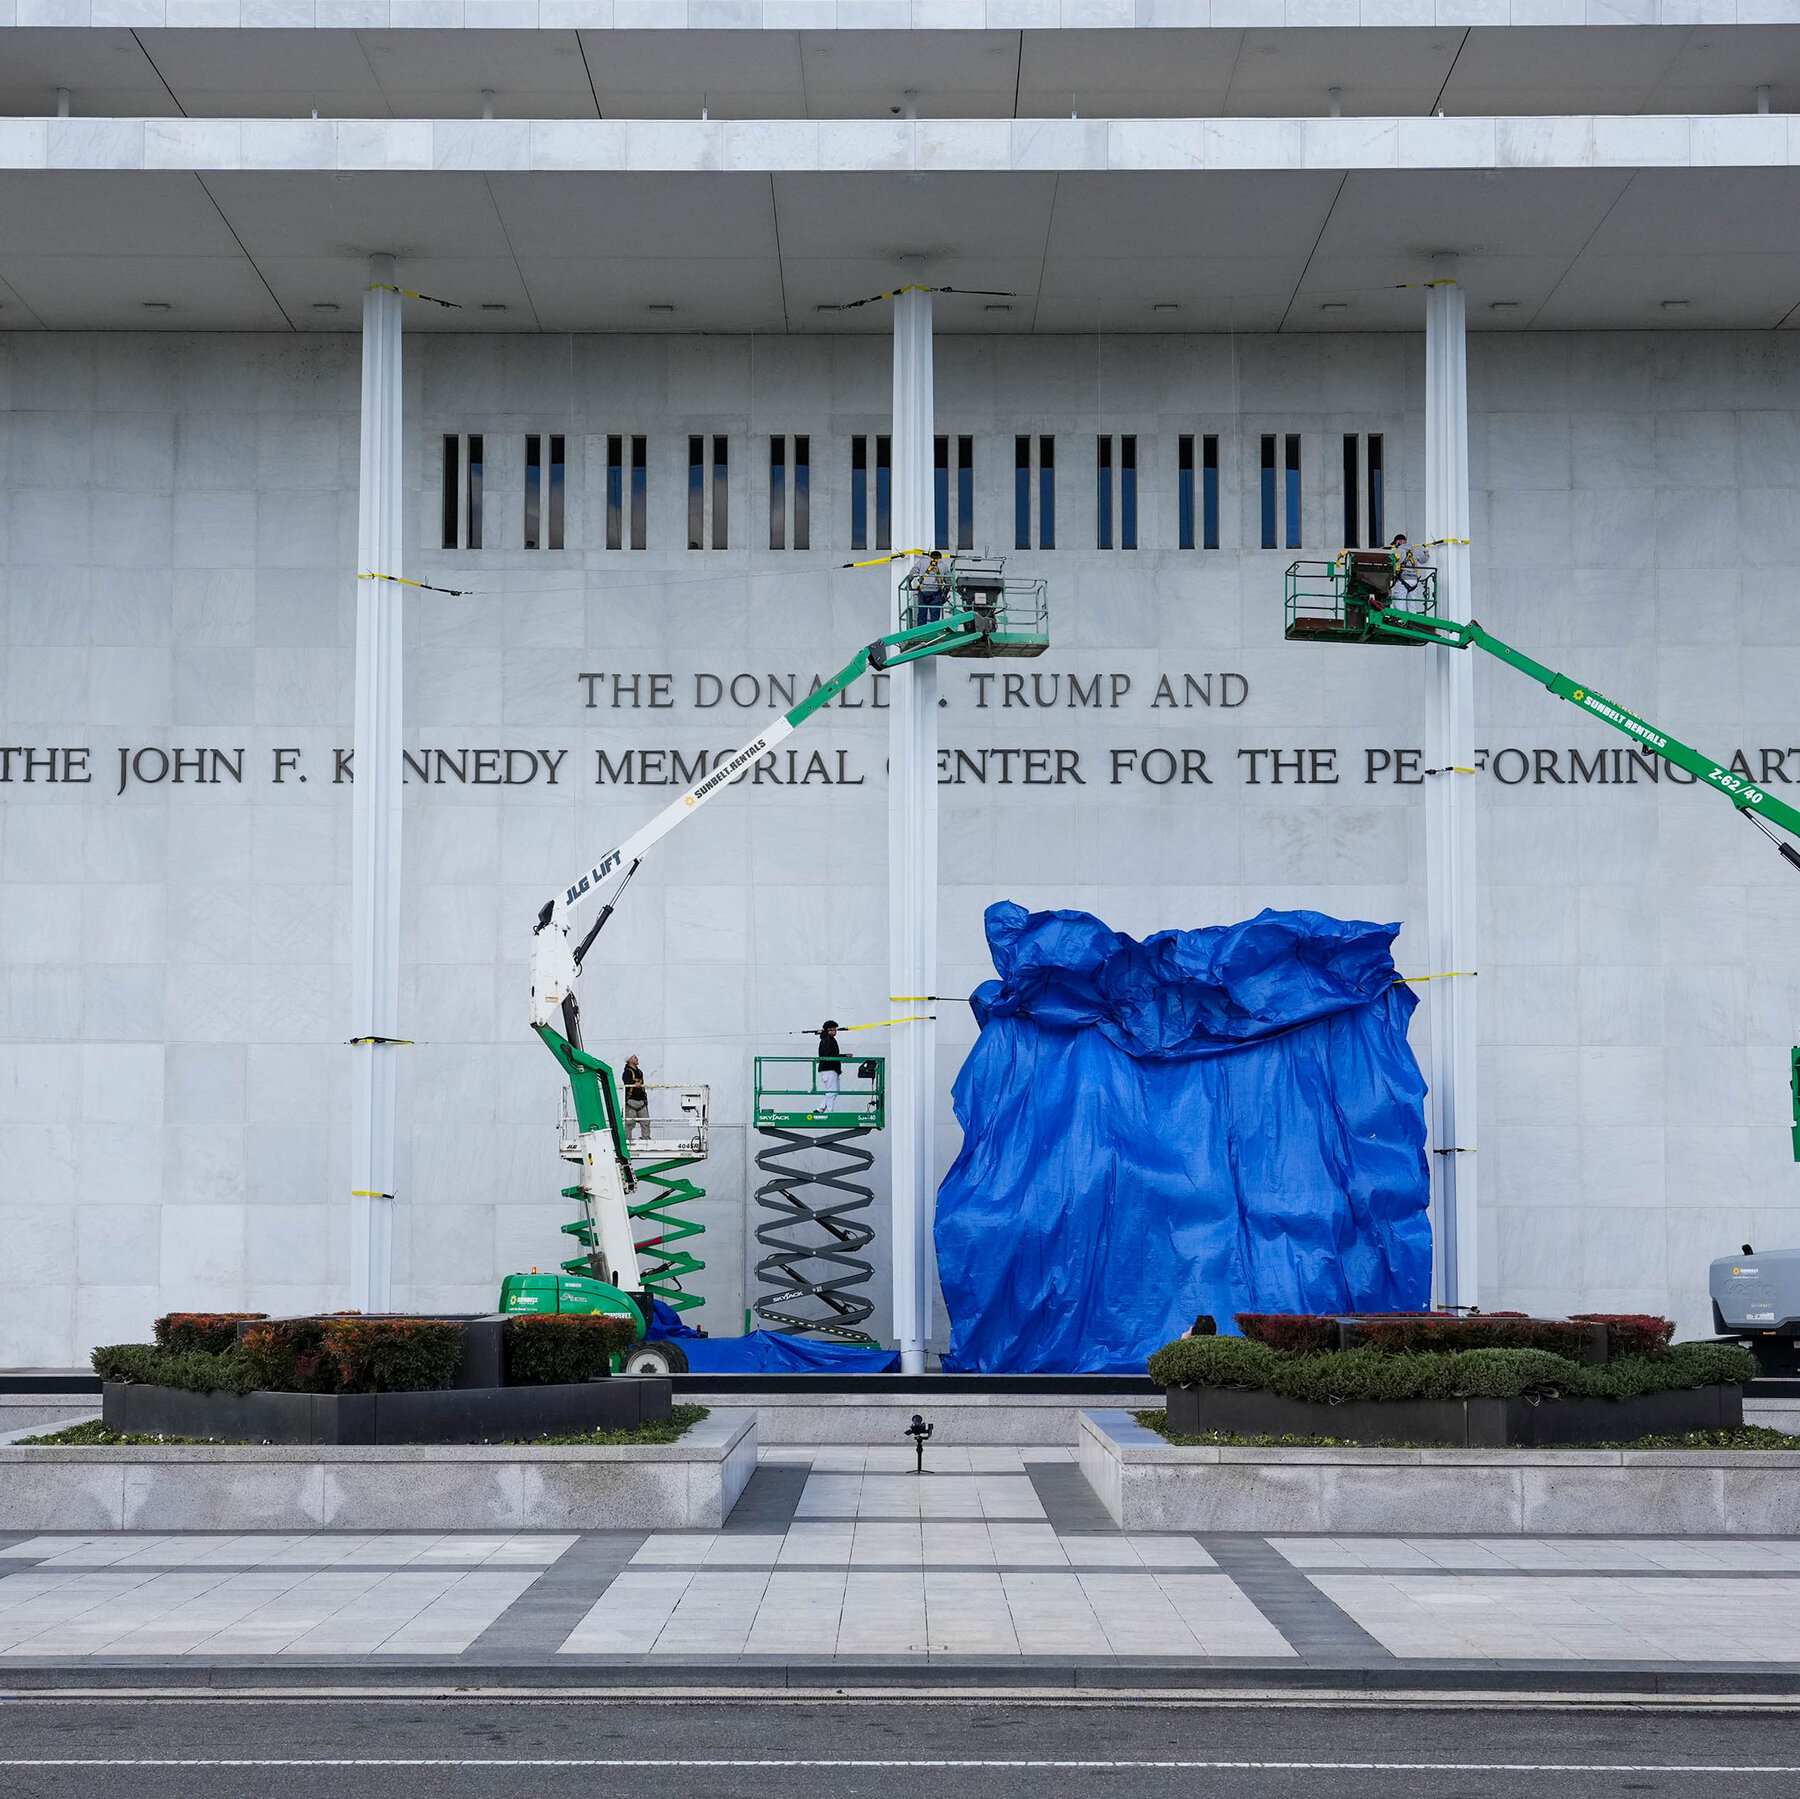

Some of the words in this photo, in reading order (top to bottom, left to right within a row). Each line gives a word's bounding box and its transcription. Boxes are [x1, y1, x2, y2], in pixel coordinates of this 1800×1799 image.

[579, 673, 674, 708] THE
[969, 673, 1131, 708] TRUMP
[1150, 673, 1249, 708] AND
[1584, 696, 1626, 724] SUNBELT
[1624, 719, 1667, 748] RENTALS
[0, 747, 92, 783] THE
[117, 747, 244, 796] JOHN
[273, 748, 308, 784] F.
[332, 748, 569, 785] KNNEDY
[1110, 748, 1213, 785] FOR
[1237, 748, 1339, 785] THE
[1364, 748, 1698, 785] PEFORMING
[1708, 768, 1763, 803] Z-62/40
[566, 876, 590, 906] JLG
[592, 850, 621, 883] LIFT
